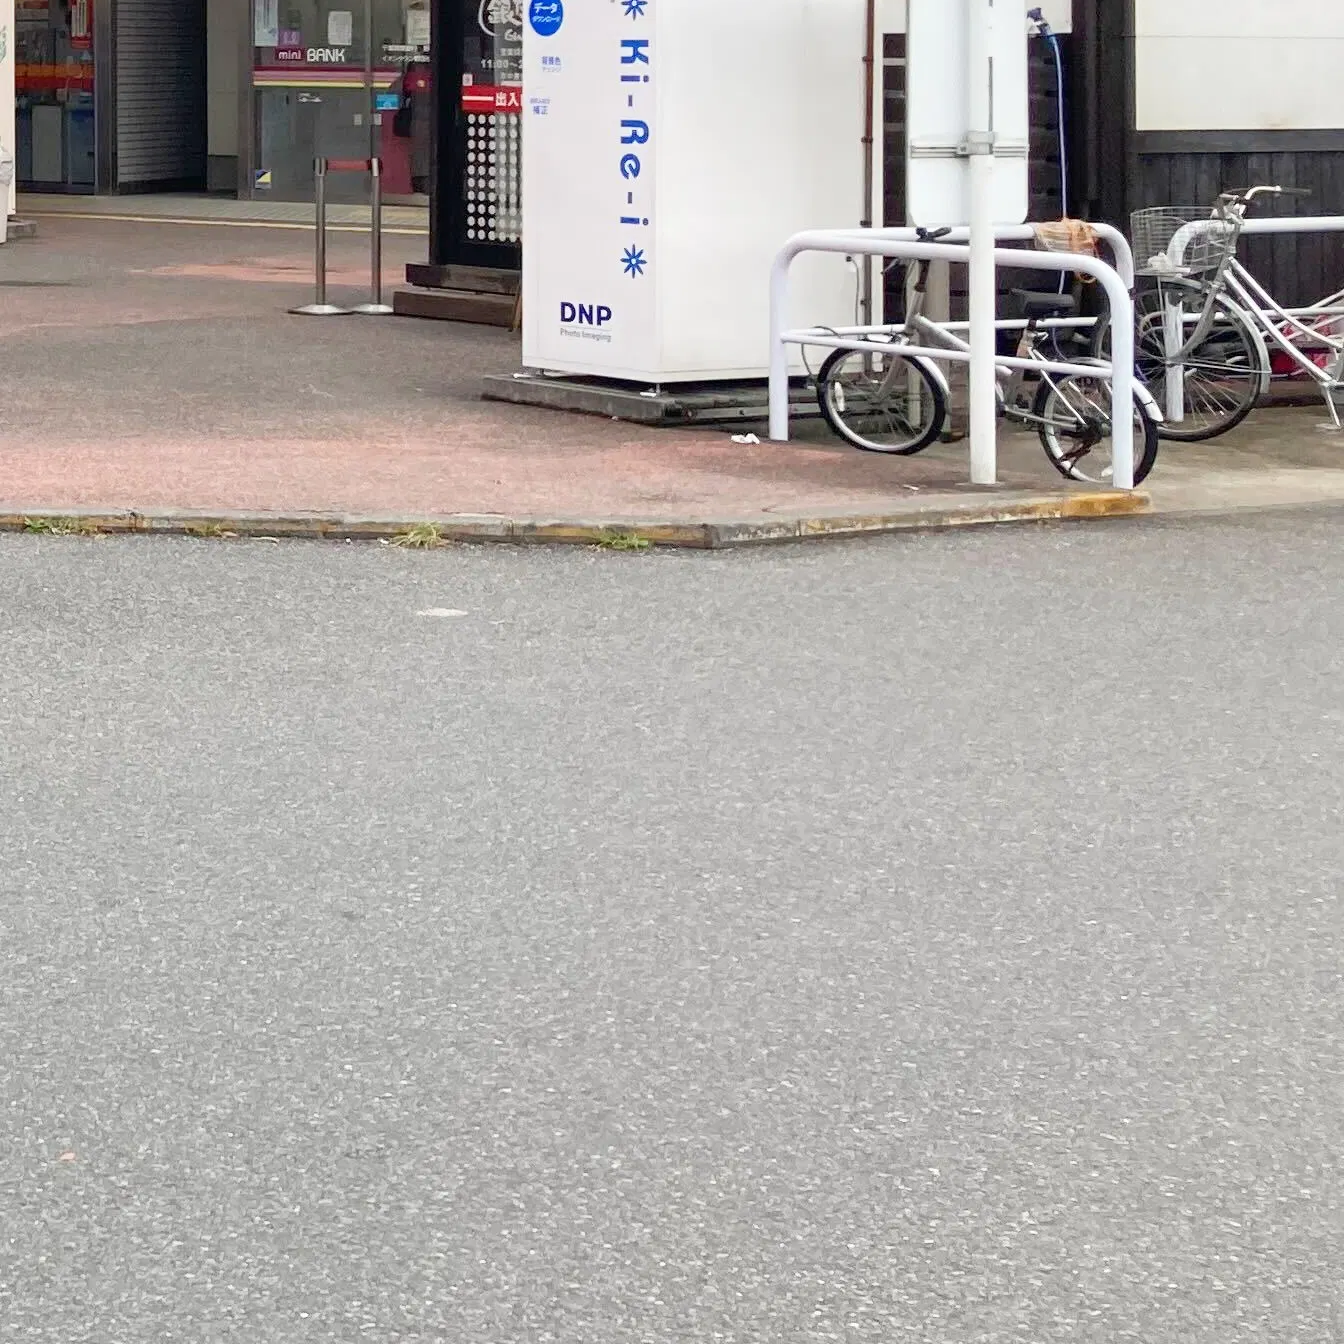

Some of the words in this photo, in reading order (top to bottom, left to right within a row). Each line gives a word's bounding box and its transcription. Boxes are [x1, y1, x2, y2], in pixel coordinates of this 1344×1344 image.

[532, 2, 559, 14] データ
[277, 50, 302, 61] mini
[306, 47, 346, 63] BANK
[495, 91, 523, 108] 出入
[559, 301, 612, 326] DNP
